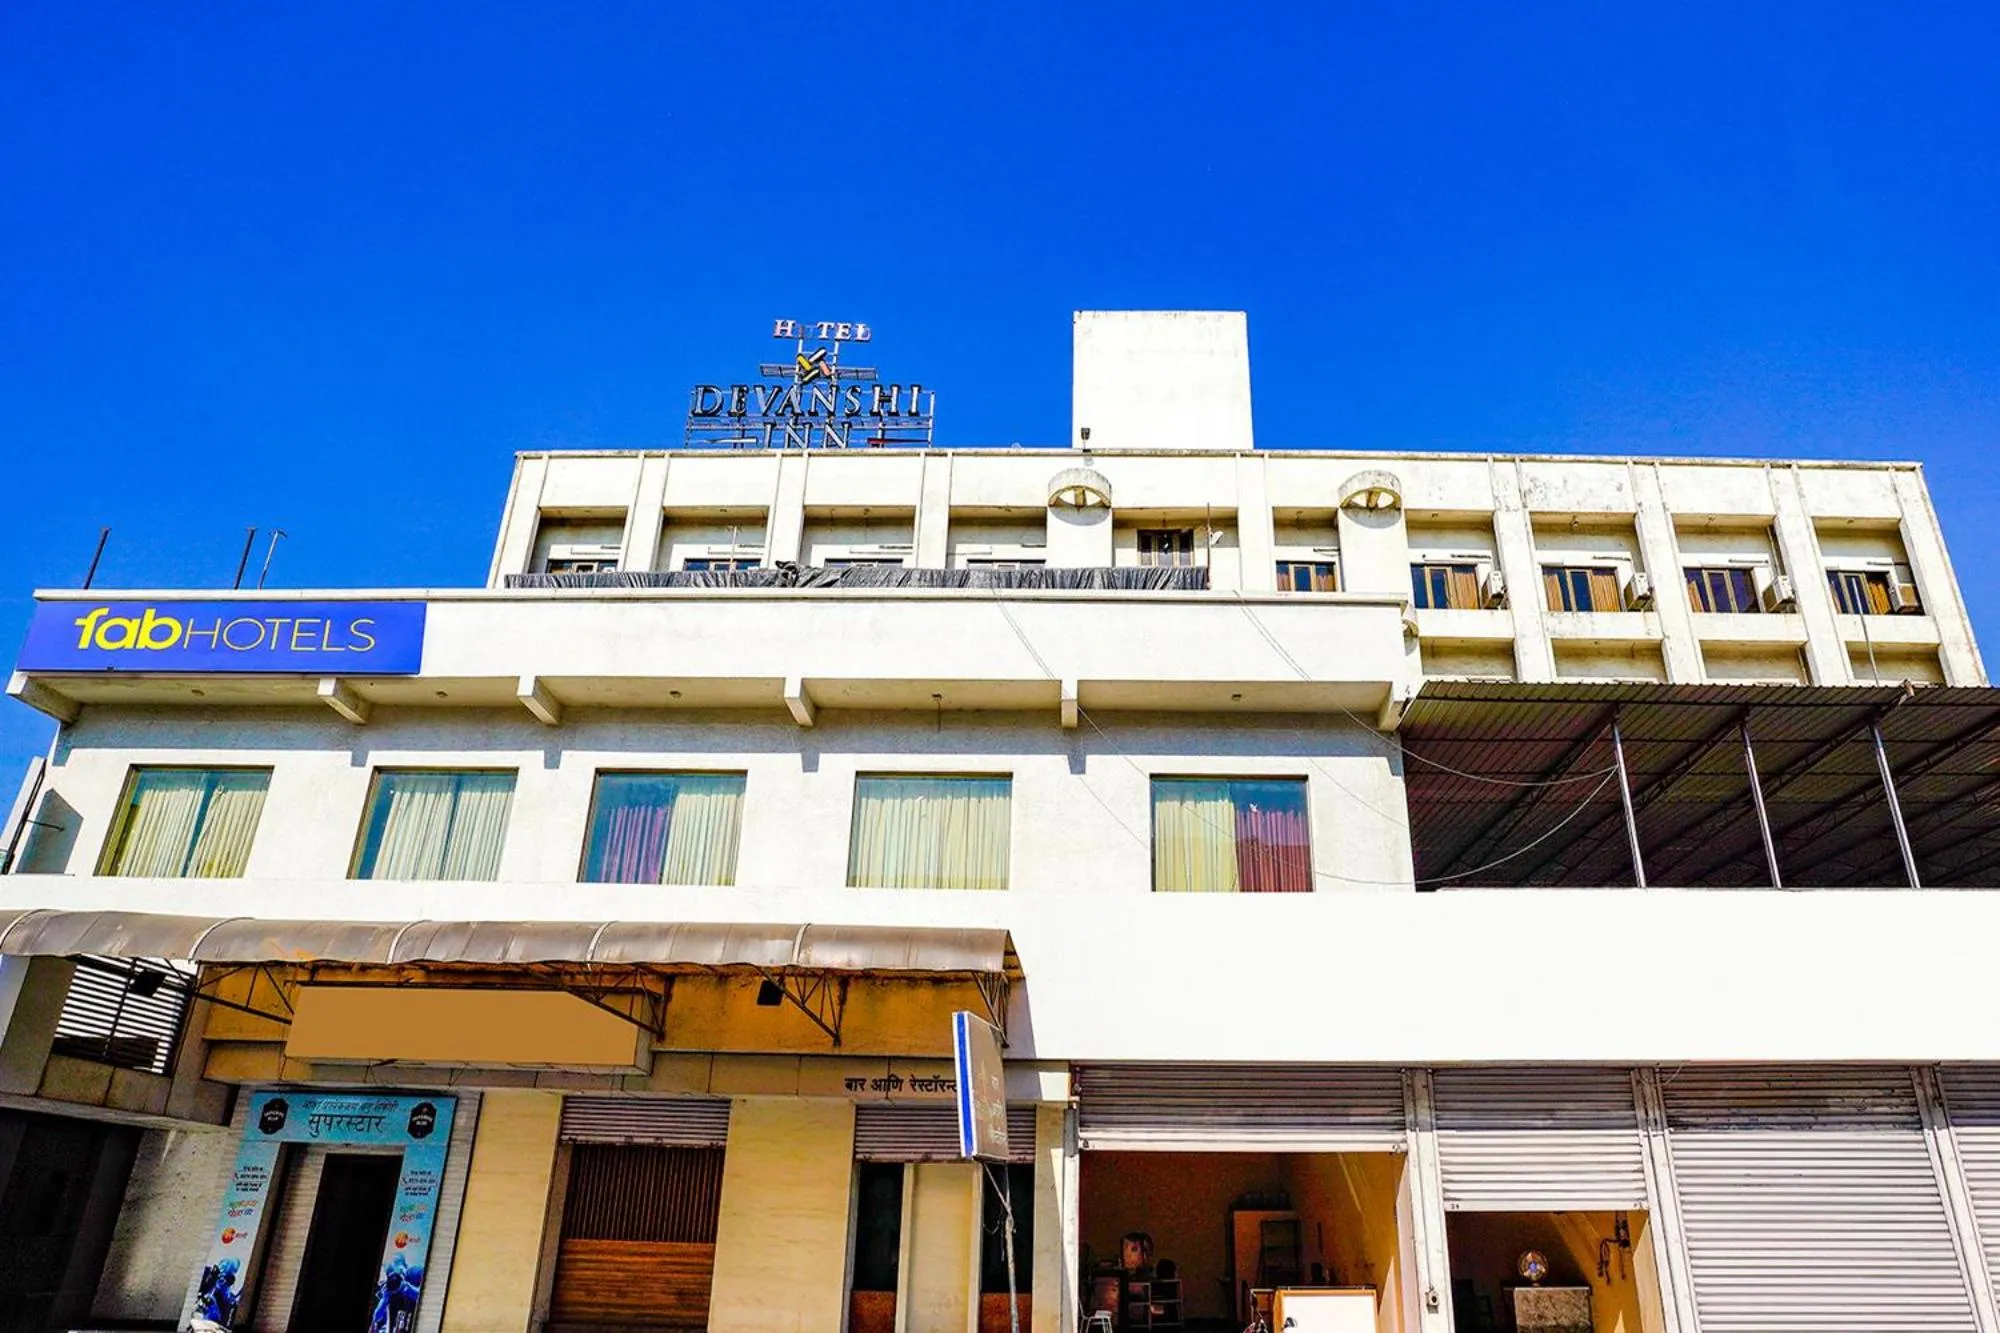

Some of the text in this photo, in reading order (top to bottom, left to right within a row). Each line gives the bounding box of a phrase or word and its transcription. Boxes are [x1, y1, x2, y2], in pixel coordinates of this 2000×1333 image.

[691, 384, 921, 417] DEVANSHI
[763, 422, 852, 449] INN
[844, 1077, 867, 1092] बार
[871, 1073, 904, 1092] आणि
[308, 1112, 387, 1138] सुपरस्टार
